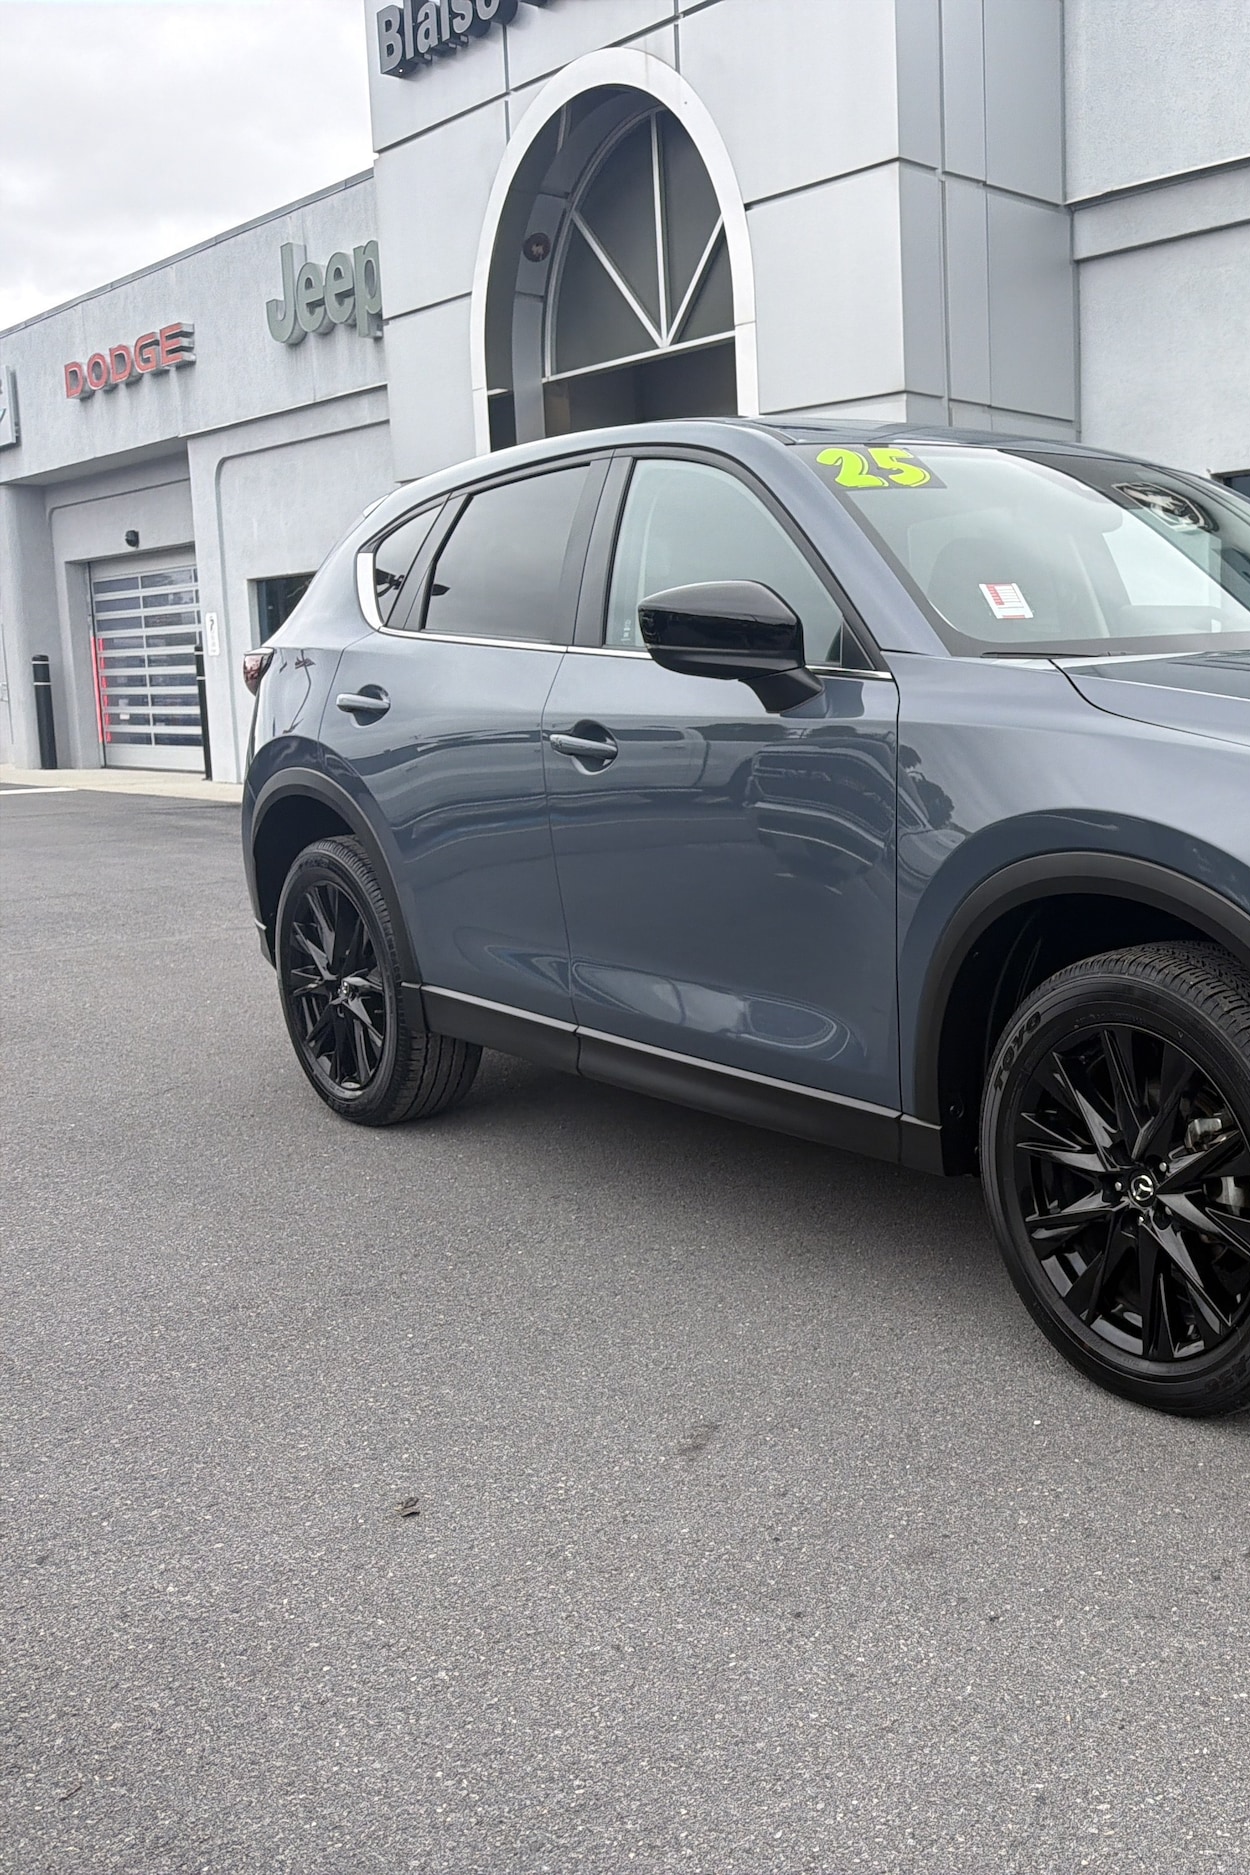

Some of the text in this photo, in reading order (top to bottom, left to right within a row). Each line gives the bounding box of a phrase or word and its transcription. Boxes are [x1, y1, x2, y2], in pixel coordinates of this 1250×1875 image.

[266, 240, 382, 345] Jeep
[64, 322, 187, 399] DODGE
[816, 447, 931, 488] 25
[994, 1011, 1041, 1091] TOYO
